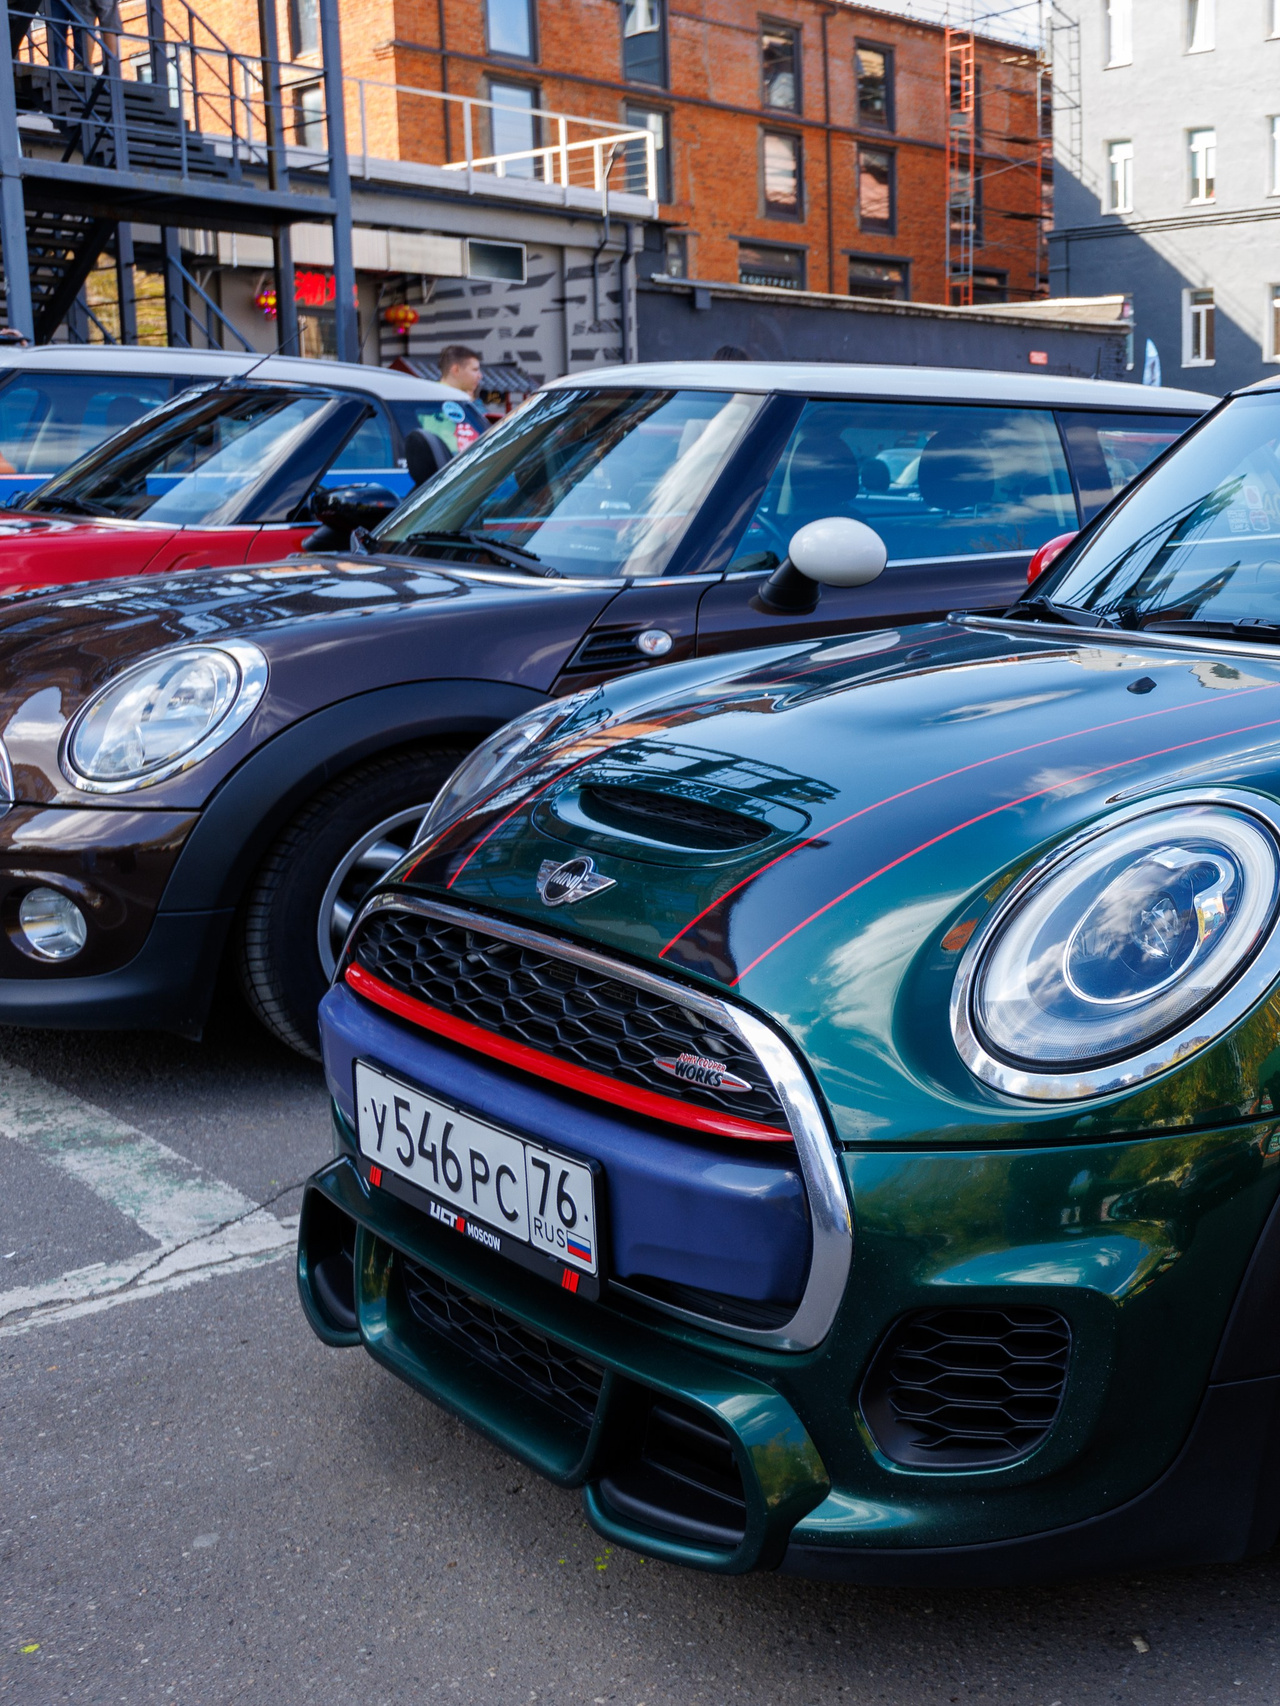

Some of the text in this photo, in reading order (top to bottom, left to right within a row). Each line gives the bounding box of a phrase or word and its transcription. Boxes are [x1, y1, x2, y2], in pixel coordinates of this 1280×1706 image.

[551, 871, 580, 889] MINI
[674, 1060, 724, 1088] WORKS
[677, 1052, 727, 1073] JOHN COOPER
[531, 1157, 577, 1229] 76
[466, 1221, 501, 1252] MOSCOW
[533, 1217, 566, 1249] RUS
